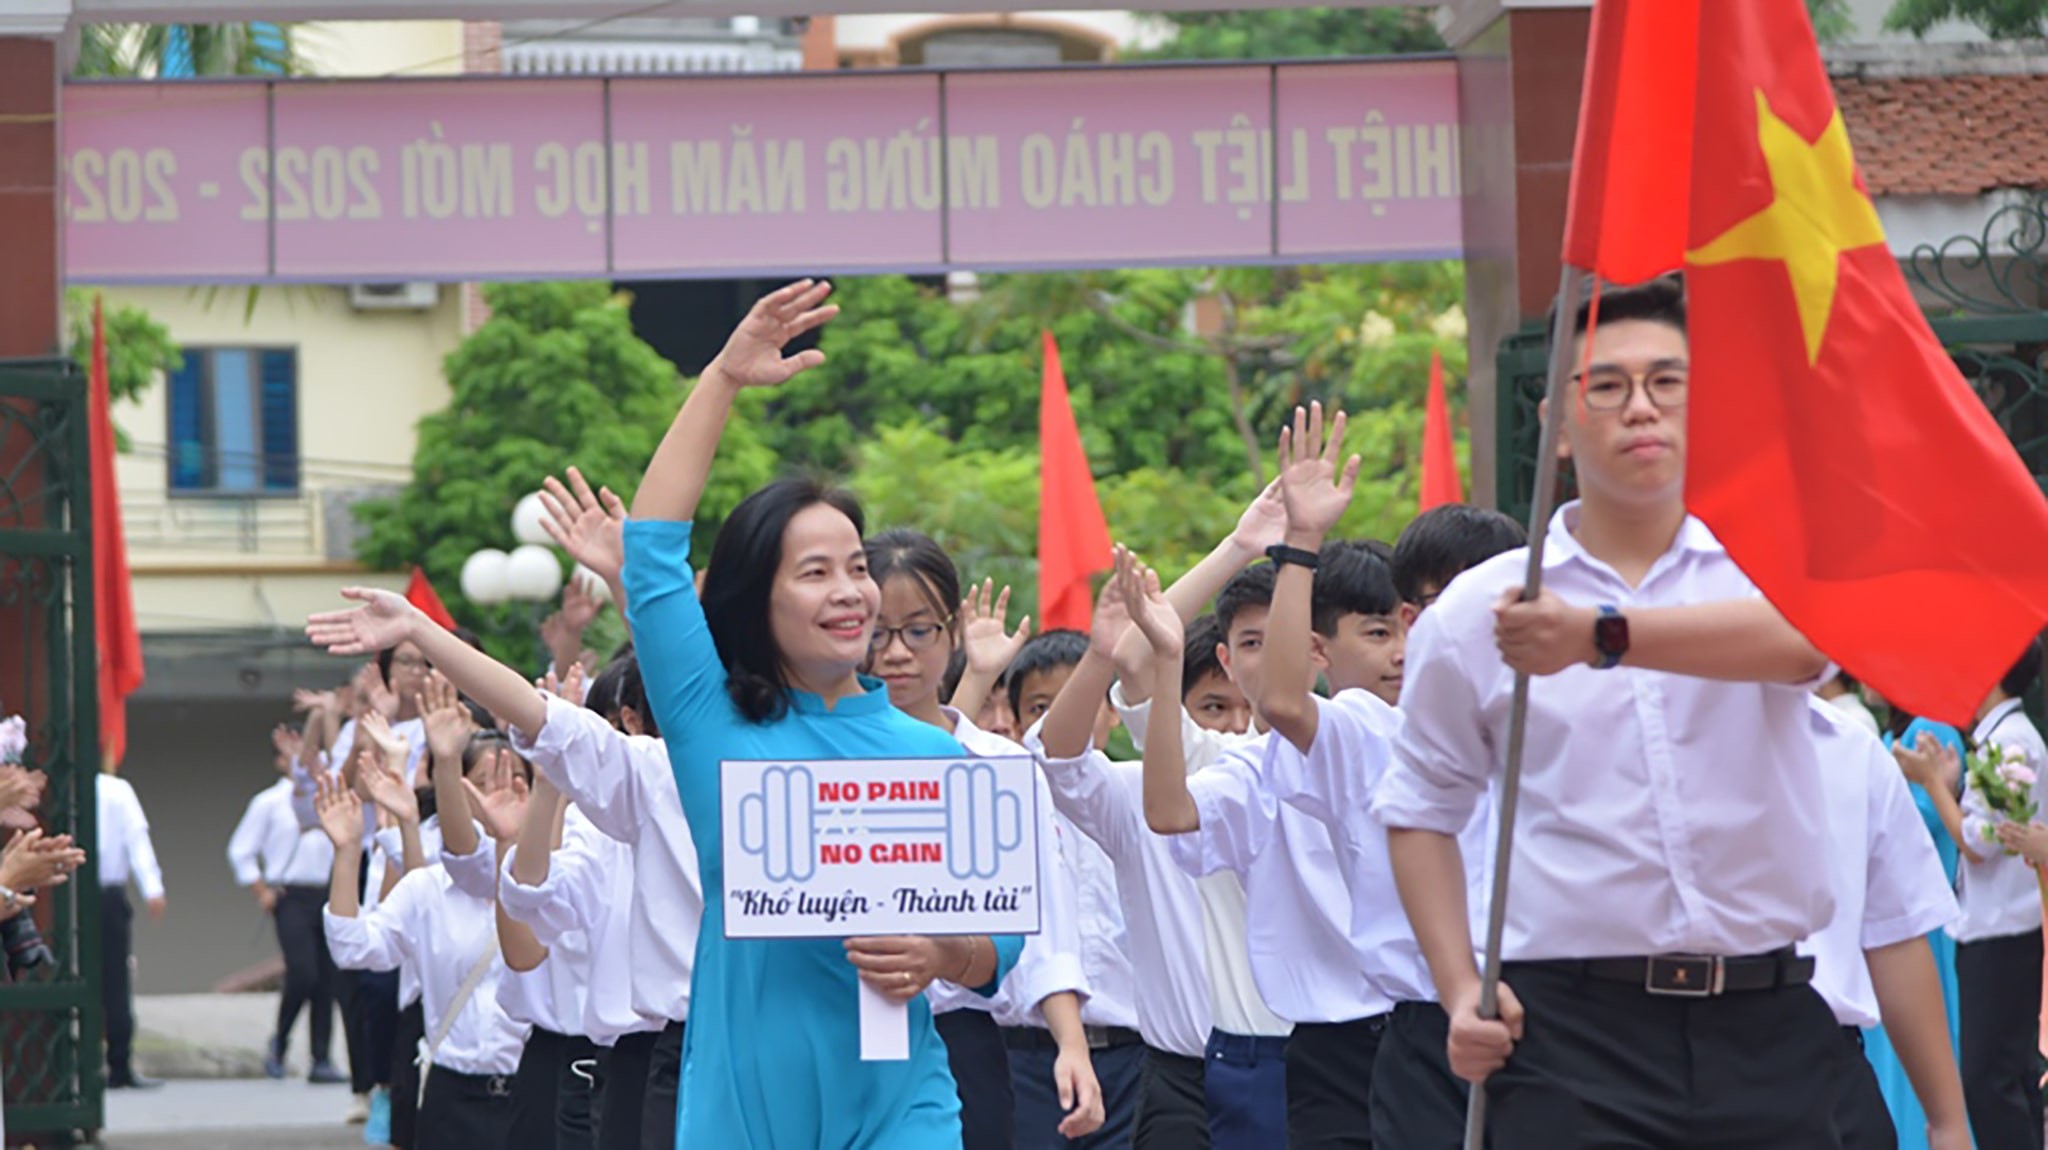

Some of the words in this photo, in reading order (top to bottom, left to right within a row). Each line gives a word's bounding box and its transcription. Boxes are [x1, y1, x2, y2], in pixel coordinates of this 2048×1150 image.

[818, 782, 860, 802] NO
[867, 781, 940, 801] PAIN
[820, 844, 862, 864] NO
[870, 843, 942, 863] GAIN
[797, 889, 869, 923] luyện
[892, 886, 977, 914] Thành
